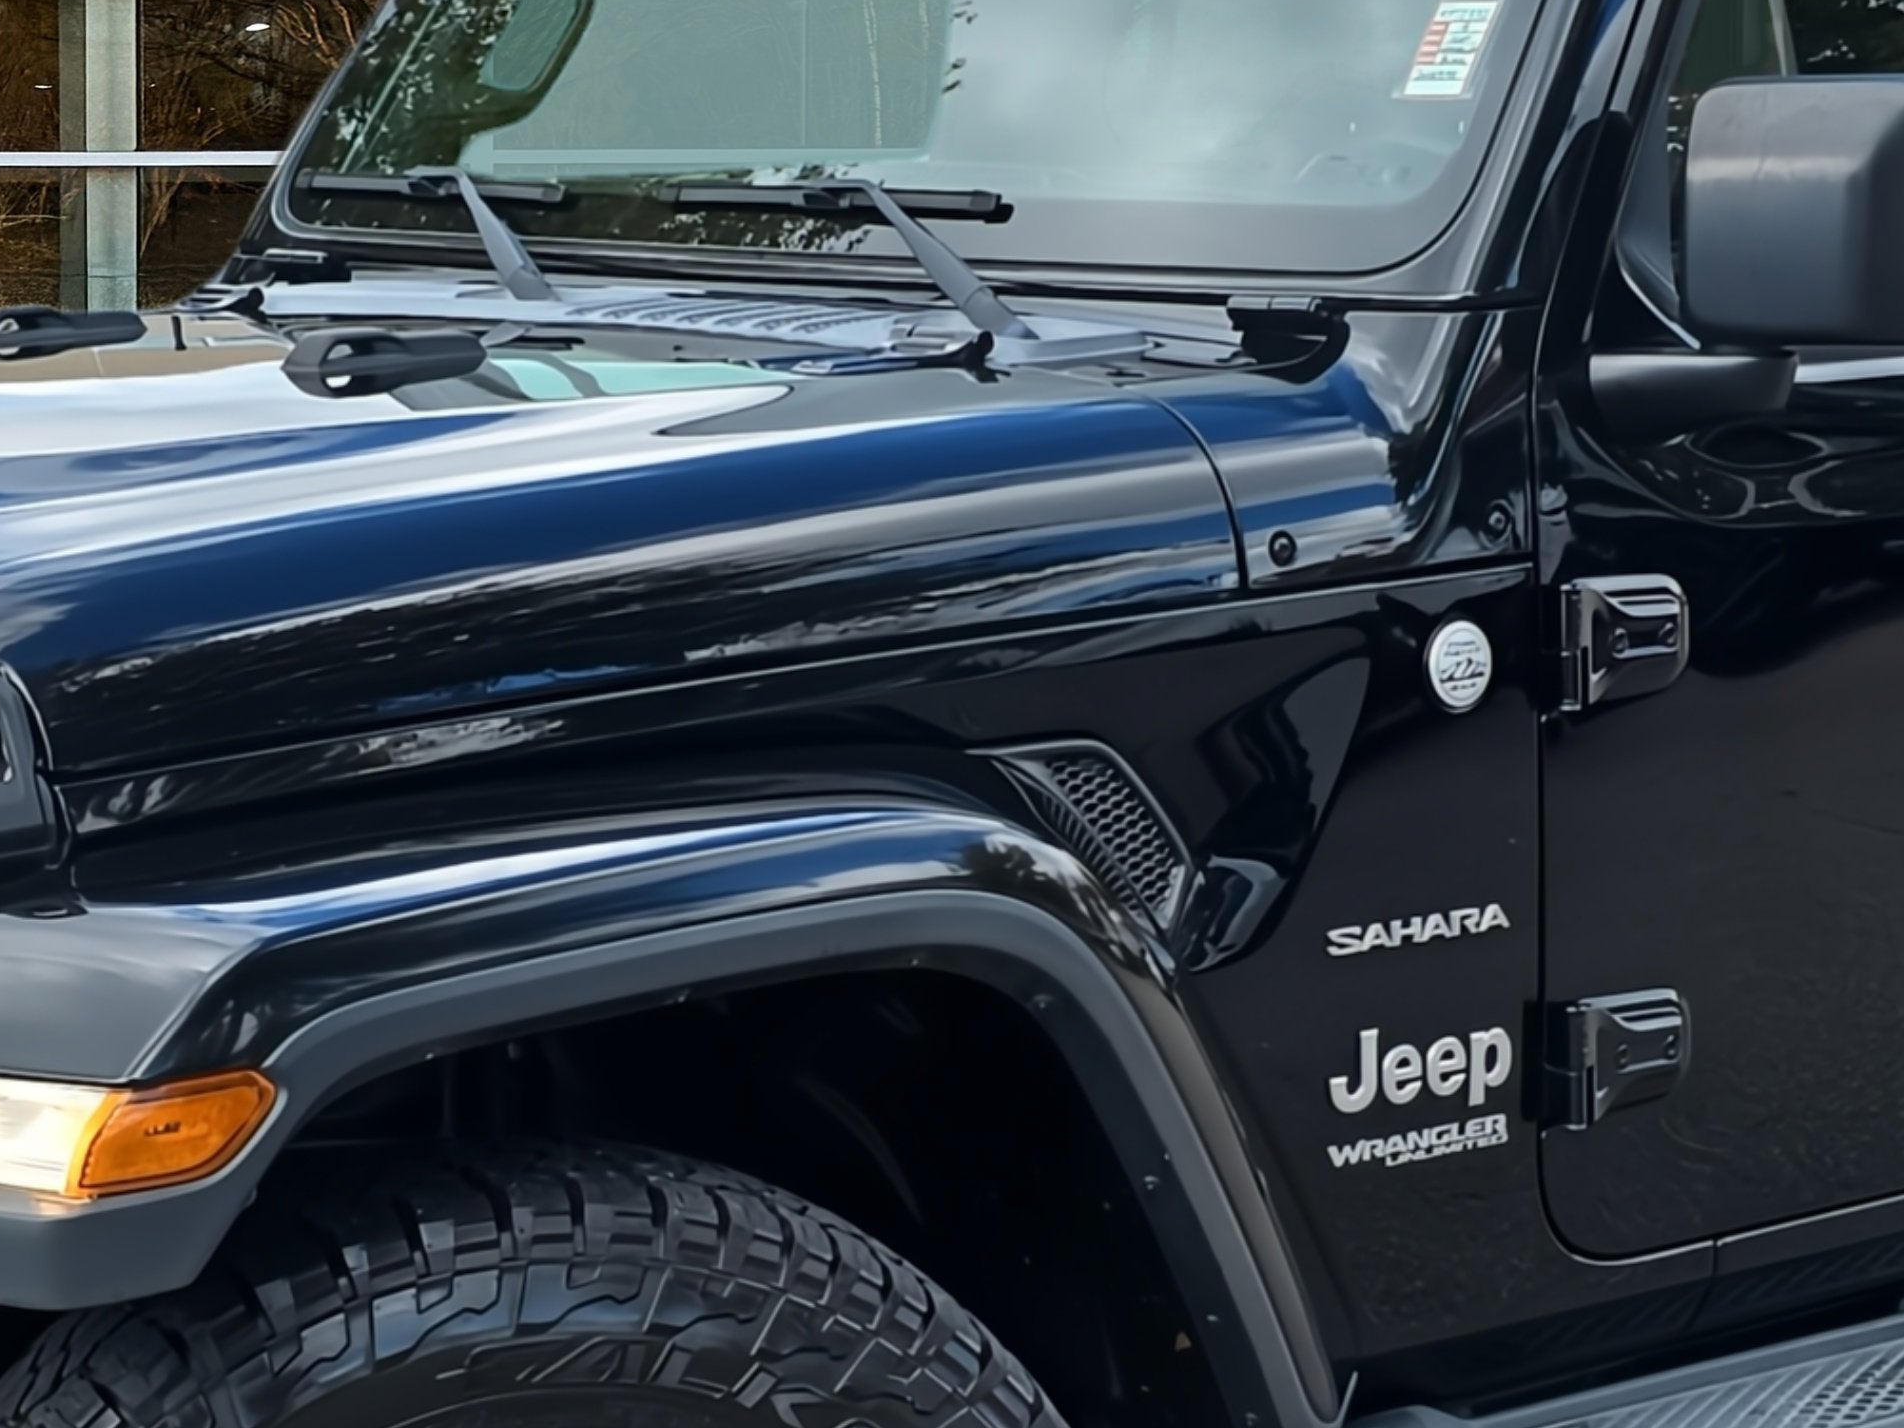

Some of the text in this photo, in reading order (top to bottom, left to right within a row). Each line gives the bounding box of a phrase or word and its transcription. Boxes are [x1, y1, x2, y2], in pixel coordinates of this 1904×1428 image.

[1326, 903, 1511, 957] SAHARA
[1329, 1027, 1513, 1114] Jeep
[1327, 1113, 1507, 1168] WRANGLER
[1385, 1134, 1509, 1167] UNLIMITED
